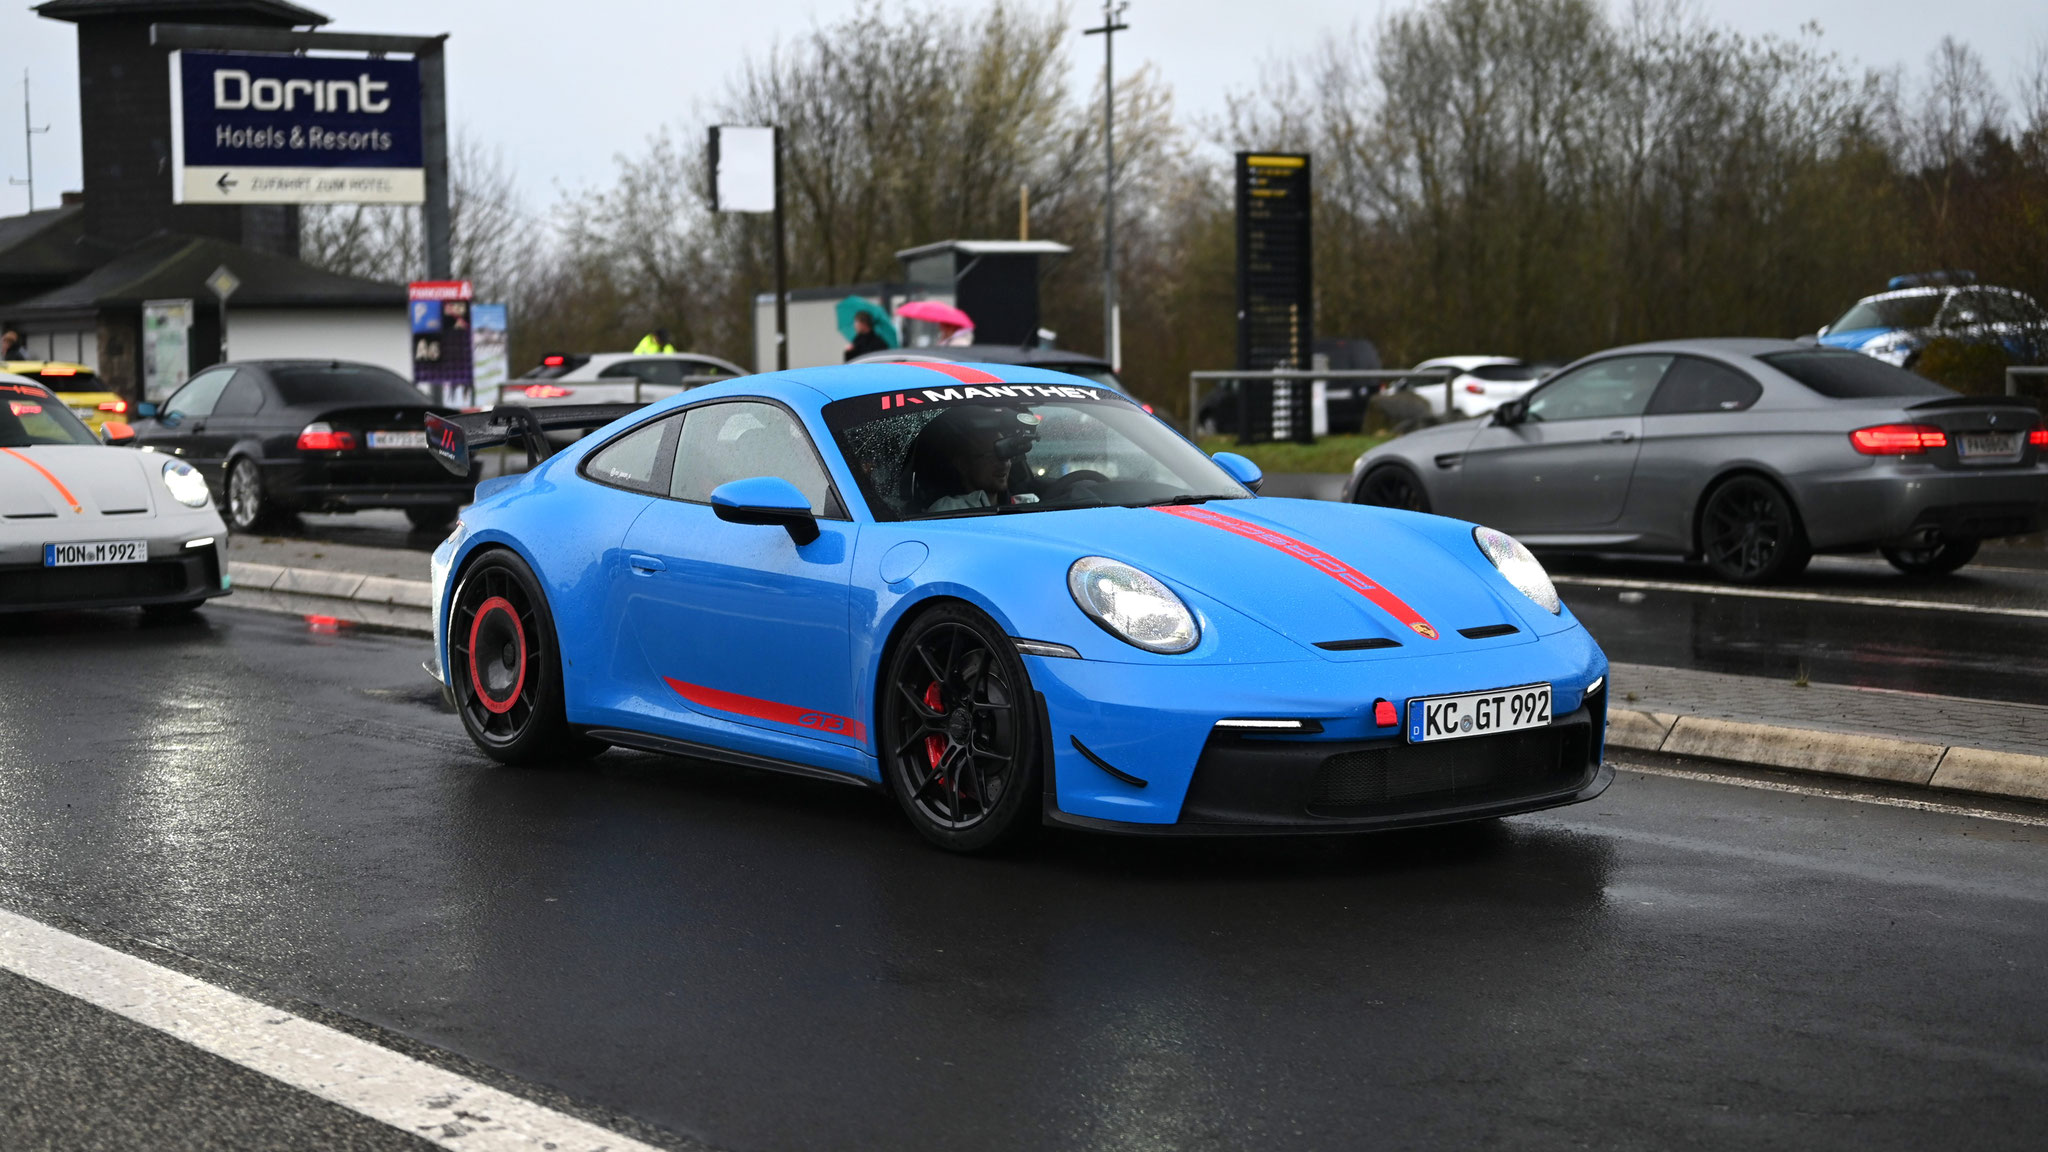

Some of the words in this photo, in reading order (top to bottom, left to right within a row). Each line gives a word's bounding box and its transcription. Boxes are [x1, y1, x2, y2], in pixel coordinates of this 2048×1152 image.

[213, 68, 391, 114] Dorint
[216, 123, 286, 149] Hotels
[289, 125, 305, 149] &
[309, 125, 392, 150] Resorts
[250, 175, 312, 193] ZUFAHRT
[315, 176, 347, 193] ZUM
[349, 177, 392, 193] HOTEL
[921, 384, 1101, 403] MANTHEY
[56, 545, 86, 563] MON
[96, 544, 106, 561] M
[109, 543, 136, 561] 992
[1181, 509, 1376, 591] PORSCHE
[798, 712, 846, 731] GT3
[1413, 726, 1420, 736] D
[1426, 702, 1459, 736] KC
[1476, 696, 1506, 730] GT
[1511, 690, 1550, 726] 992
